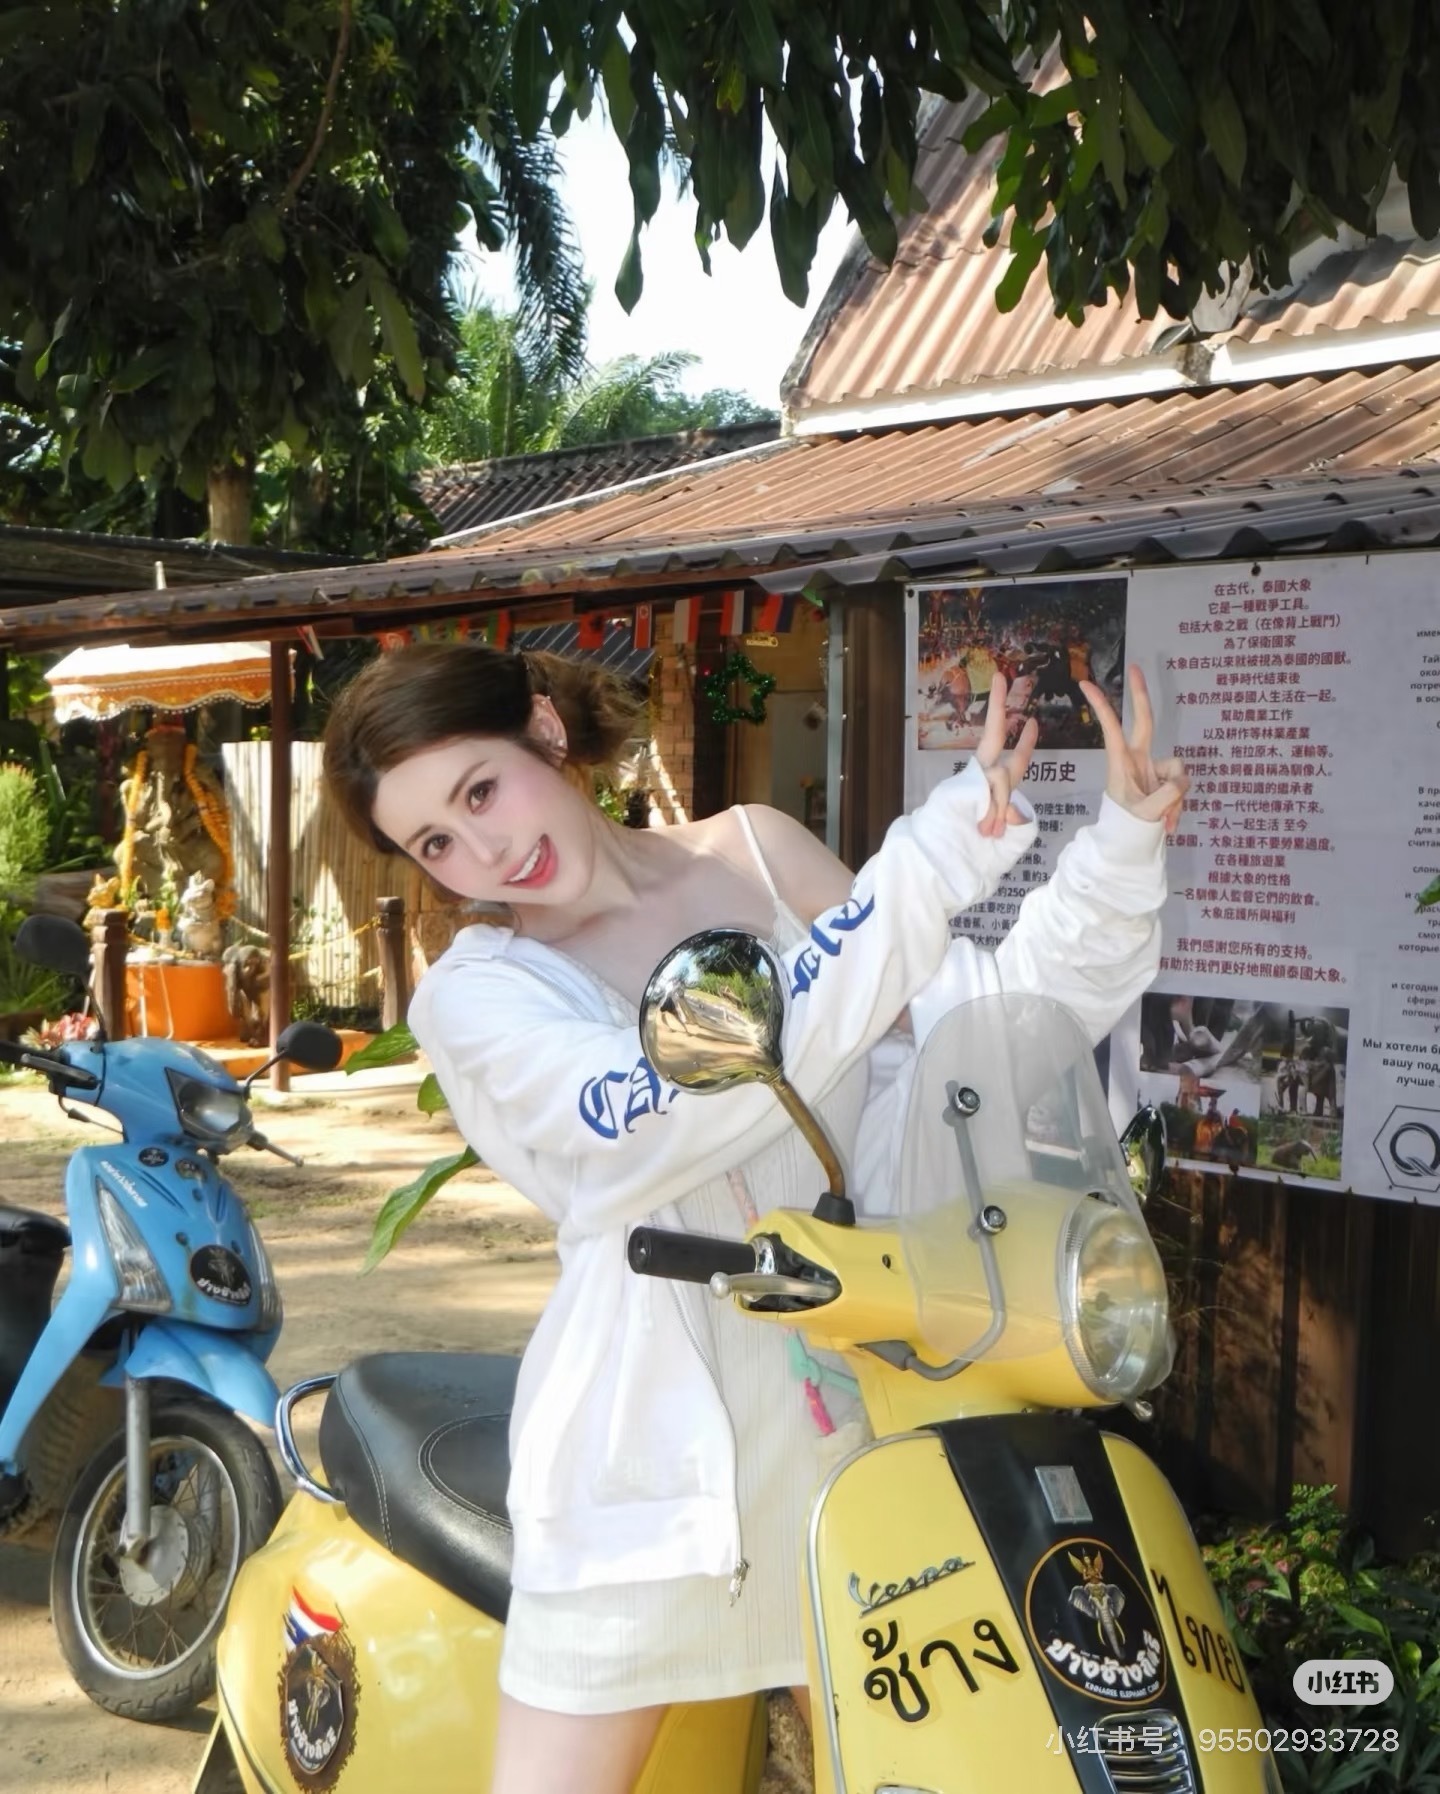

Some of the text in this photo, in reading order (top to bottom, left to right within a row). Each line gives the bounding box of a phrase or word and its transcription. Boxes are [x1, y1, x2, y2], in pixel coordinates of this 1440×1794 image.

[1362, 1038, 1382, 1049] Мы
[1386, 1042, 1427, 1053] хотели
[1382, 1058, 1413, 1070] вашу
[1396, 1076, 1435, 1087] лучше
[1150, 1568, 1246, 1694] ไทย
[862, 1619, 1020, 1722] ช้าง
